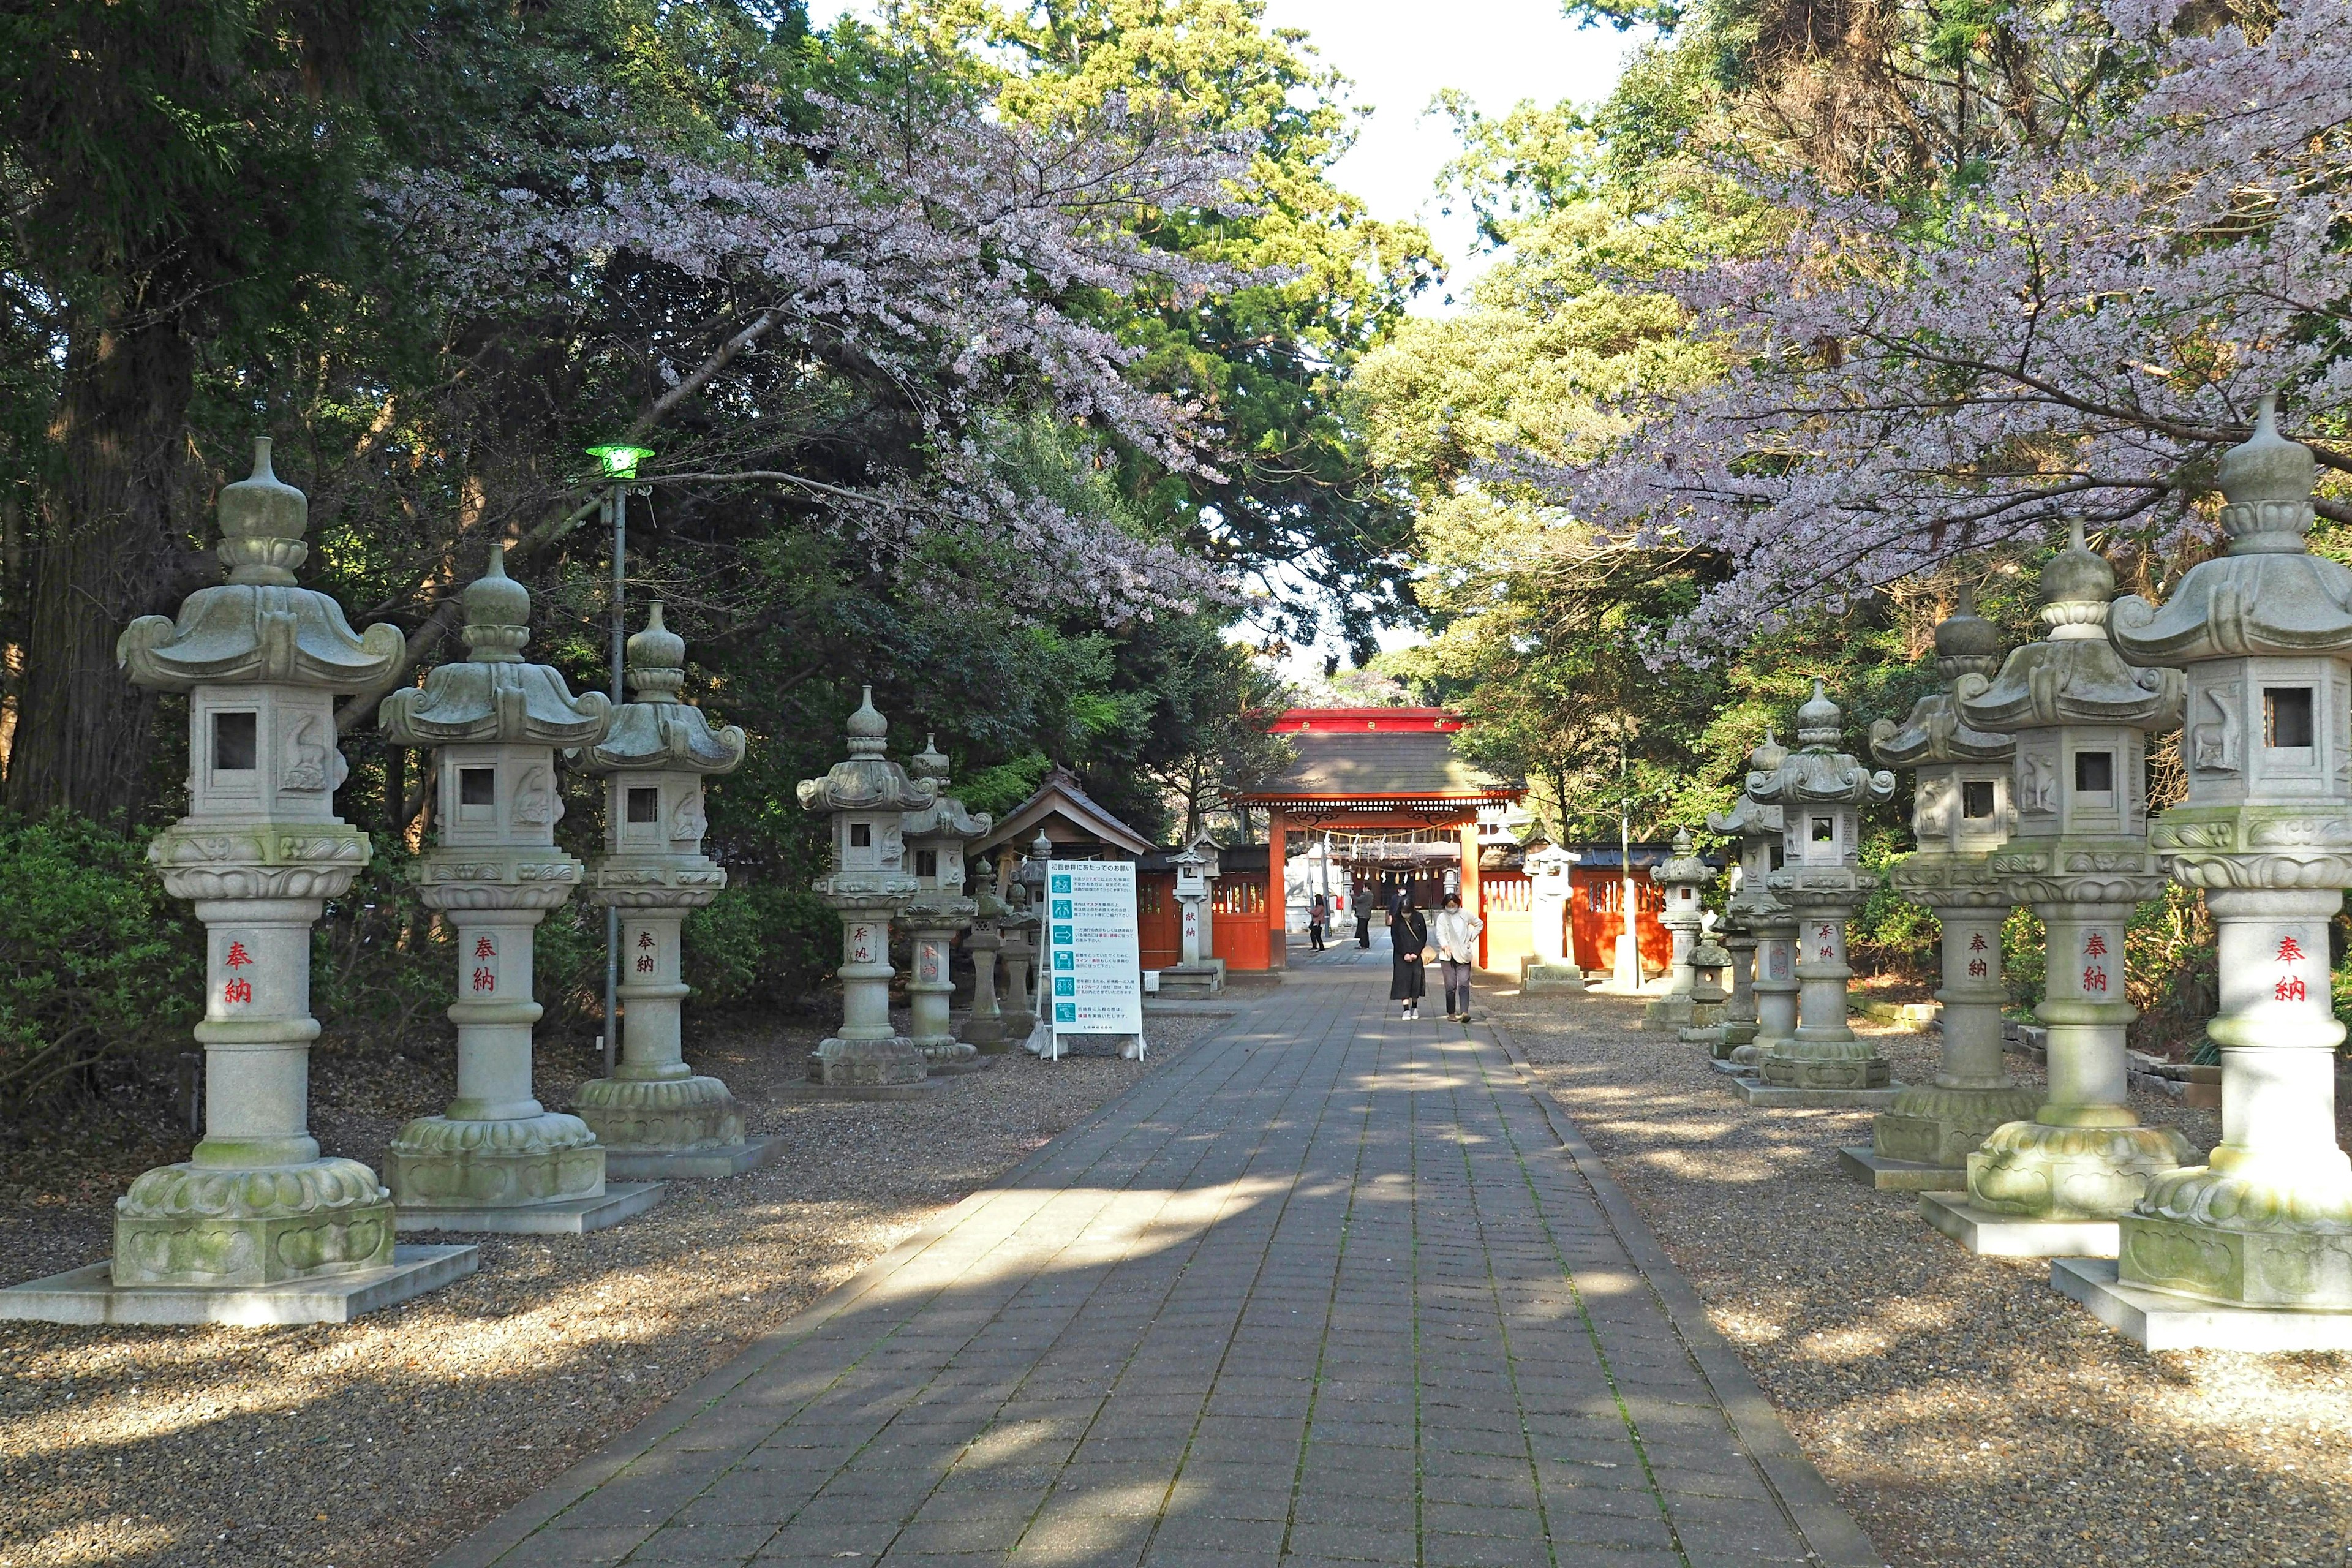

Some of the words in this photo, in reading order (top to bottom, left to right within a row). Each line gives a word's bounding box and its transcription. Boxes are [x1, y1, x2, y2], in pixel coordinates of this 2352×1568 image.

[637, 931, 656, 972] 奉納
[1186, 912, 1196, 937] 献納
[225, 941, 254, 1004] 奉納
[473, 936, 497, 992] 奉納
[1968, 933, 1989, 977] 奉納
[2083, 933, 2108, 992] 奉納
[2274, 935, 2306, 1002] 奉納
